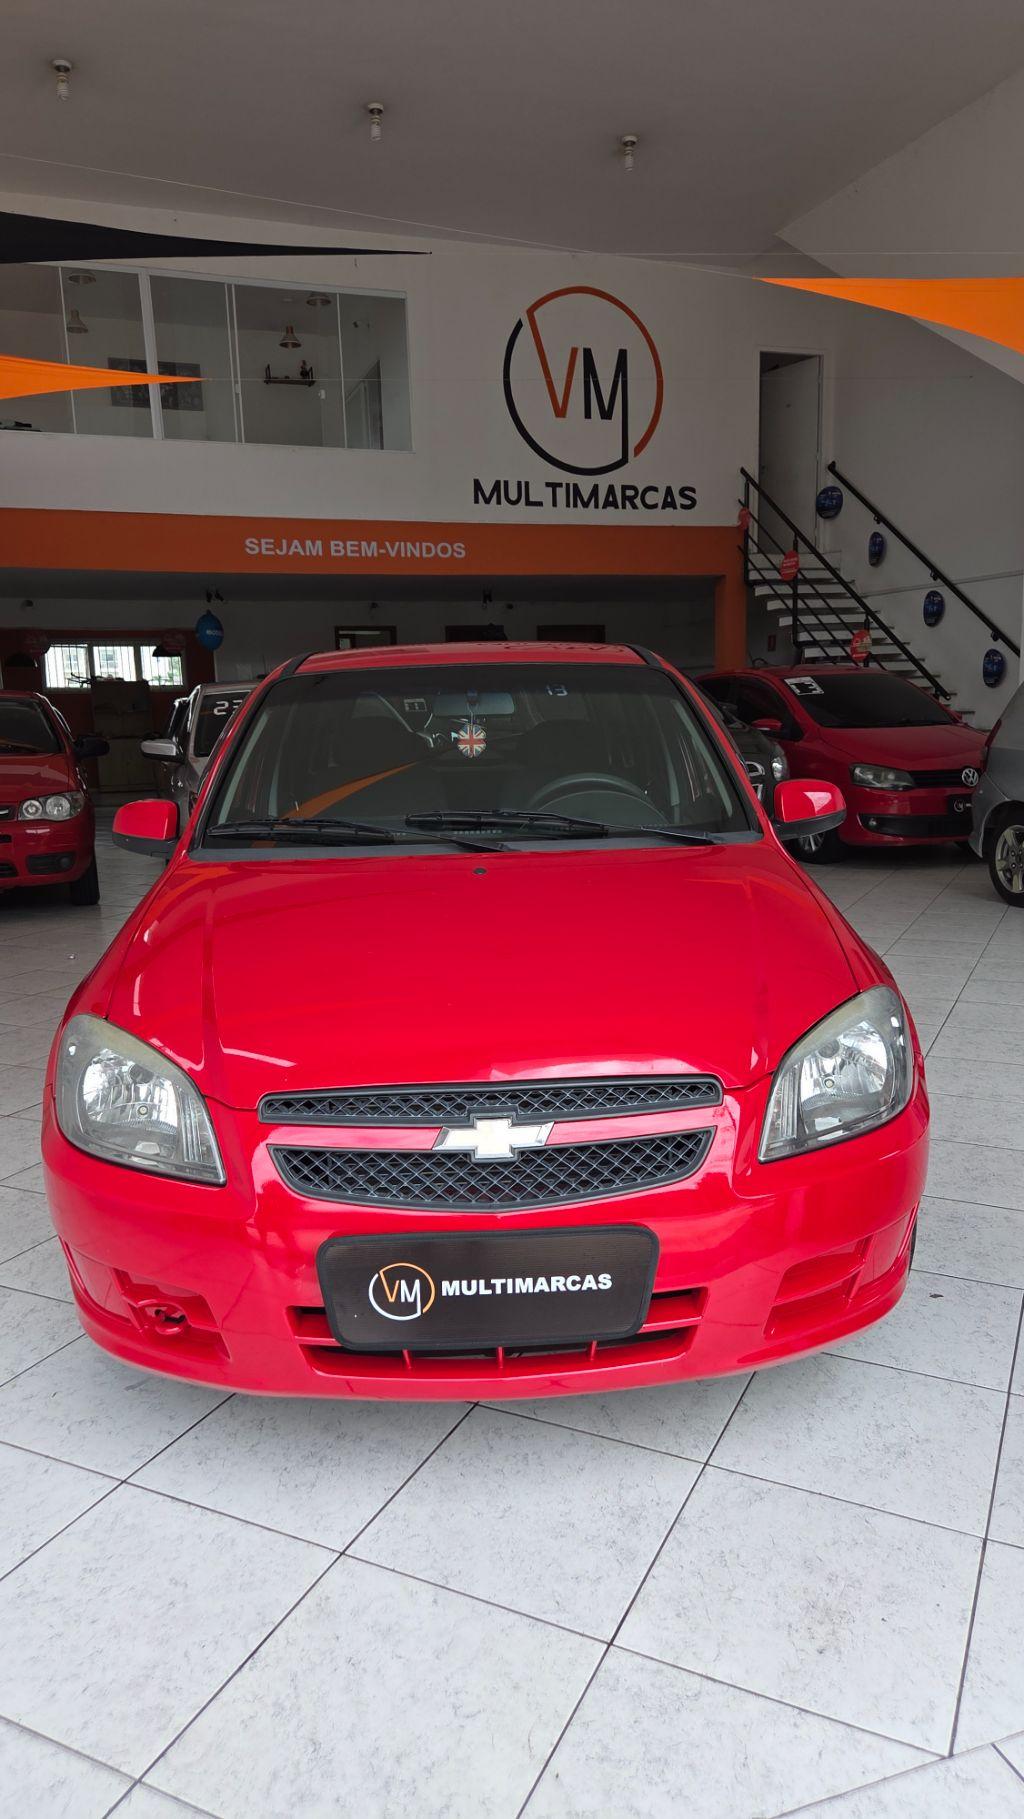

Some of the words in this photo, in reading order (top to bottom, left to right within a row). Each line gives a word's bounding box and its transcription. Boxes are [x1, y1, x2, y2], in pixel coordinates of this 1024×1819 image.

[473, 478, 698, 511] MULTIMARCAS
[244, 537, 324, 557] SEJAM
[329, 539, 467, 560] BEM-VINDOS
[441, 1273, 613, 1297] MULTIMARCAS
